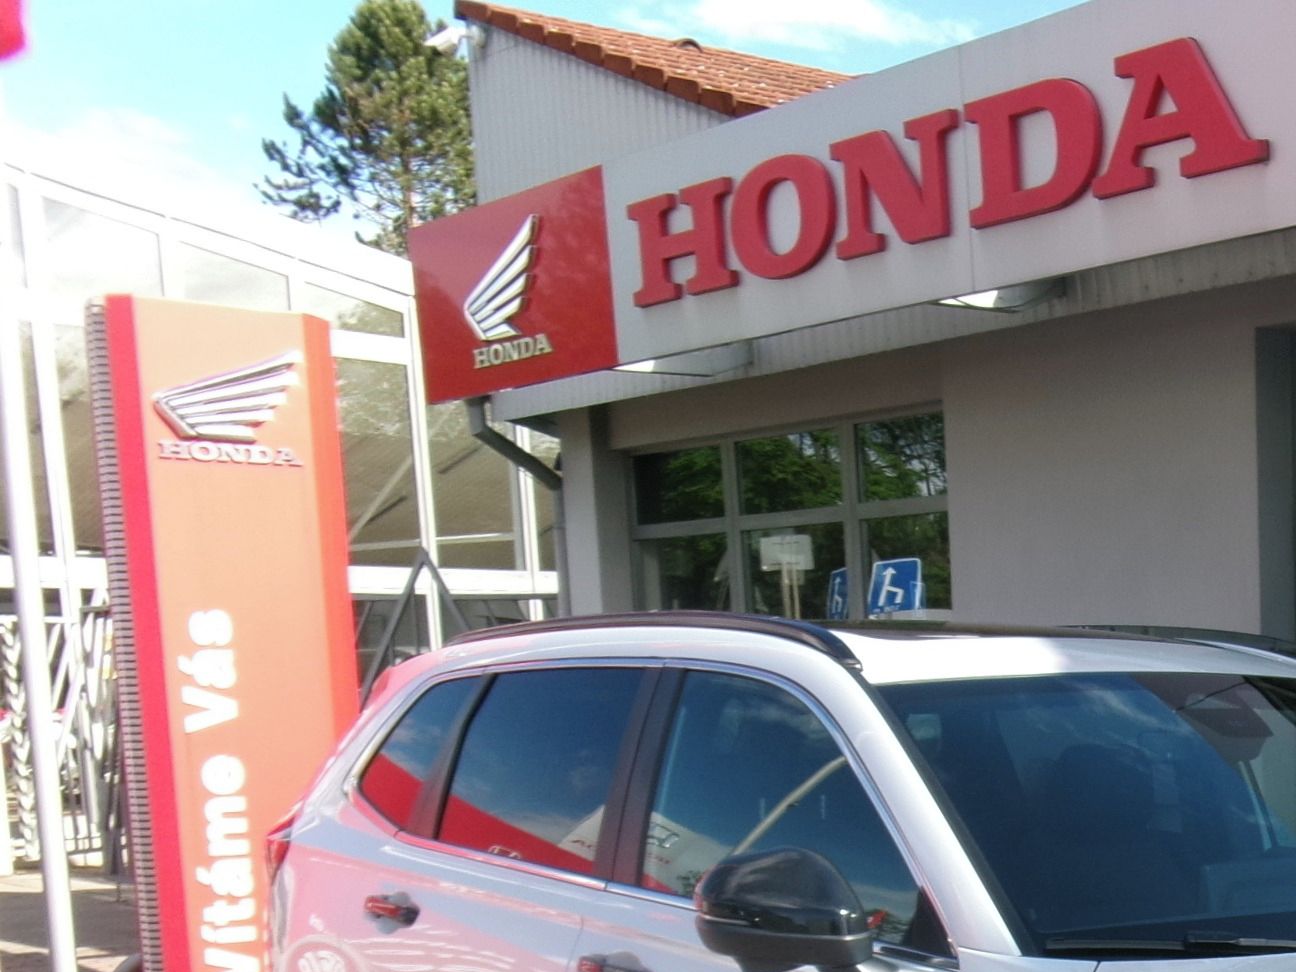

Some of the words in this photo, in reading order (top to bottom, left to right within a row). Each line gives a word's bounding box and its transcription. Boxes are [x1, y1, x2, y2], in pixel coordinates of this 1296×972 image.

[627, 37, 1269, 307] HONDA
[473, 333, 553, 369] HONDA
[157, 439, 304, 468] HONDA
[177, 608, 240, 733] Vás
